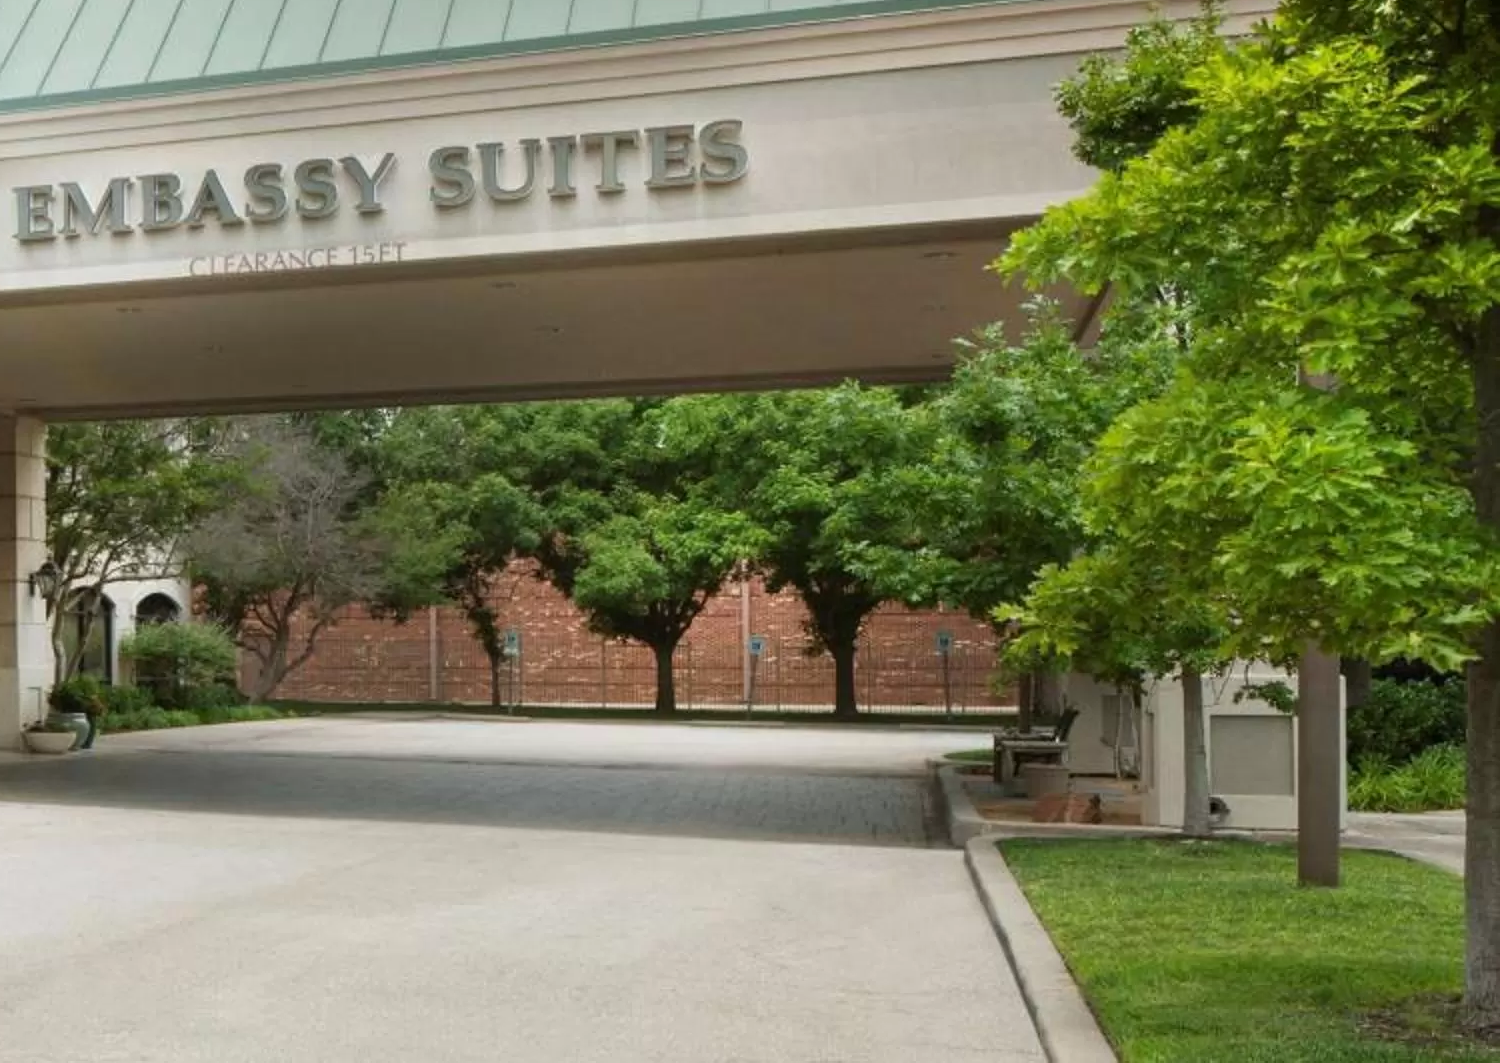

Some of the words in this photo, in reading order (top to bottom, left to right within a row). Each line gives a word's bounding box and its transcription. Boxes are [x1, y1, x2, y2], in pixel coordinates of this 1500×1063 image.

[12, 152, 396, 242] EMBASSY
[428, 119, 750, 208] SUITES
[188, 246, 338, 278] CLEARANCE
